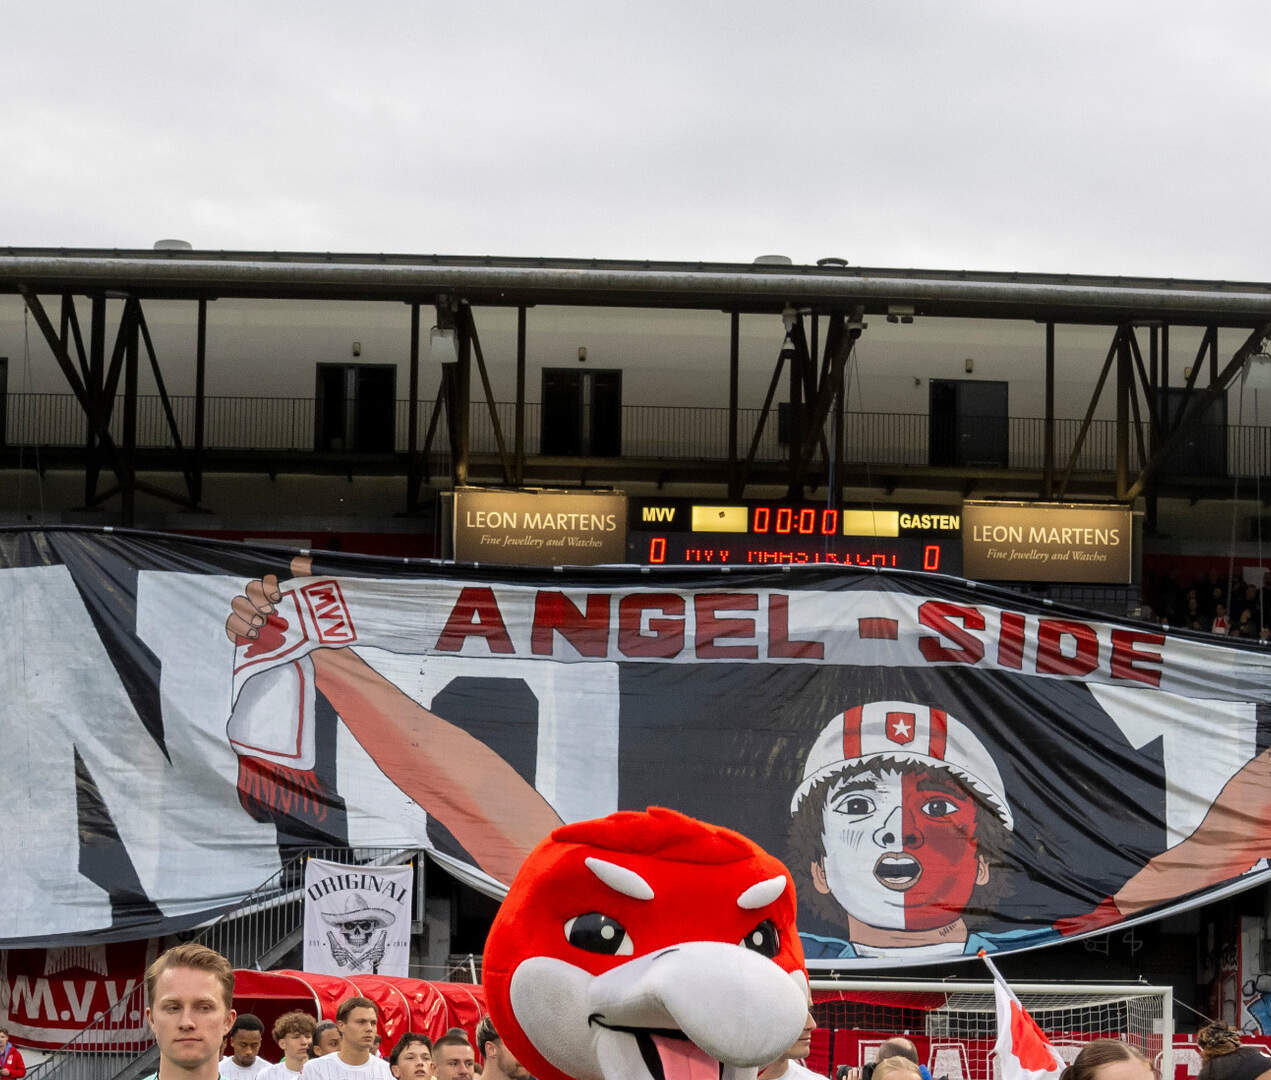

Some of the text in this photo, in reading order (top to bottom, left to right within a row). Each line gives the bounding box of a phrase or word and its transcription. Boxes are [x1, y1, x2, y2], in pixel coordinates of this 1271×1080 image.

[466, 511, 617, 531] LEON MARTENS
[642, 507, 960, 535] MVV 00:00 GASTEN
[480, 535, 603, 549] Fine Jewellery and Watches
[973, 525, 1120, 546] LEON MARTENS
[649, 537, 666, 563] 0
[923, 544, 941, 571] 0
[986, 548, 1107, 563] Fine Jewellery and Watches
[308, 587, 348, 637] MVV
[434, 586, 824, 660] ANGEL
[307, 873, 407, 905] ORIGINAL
